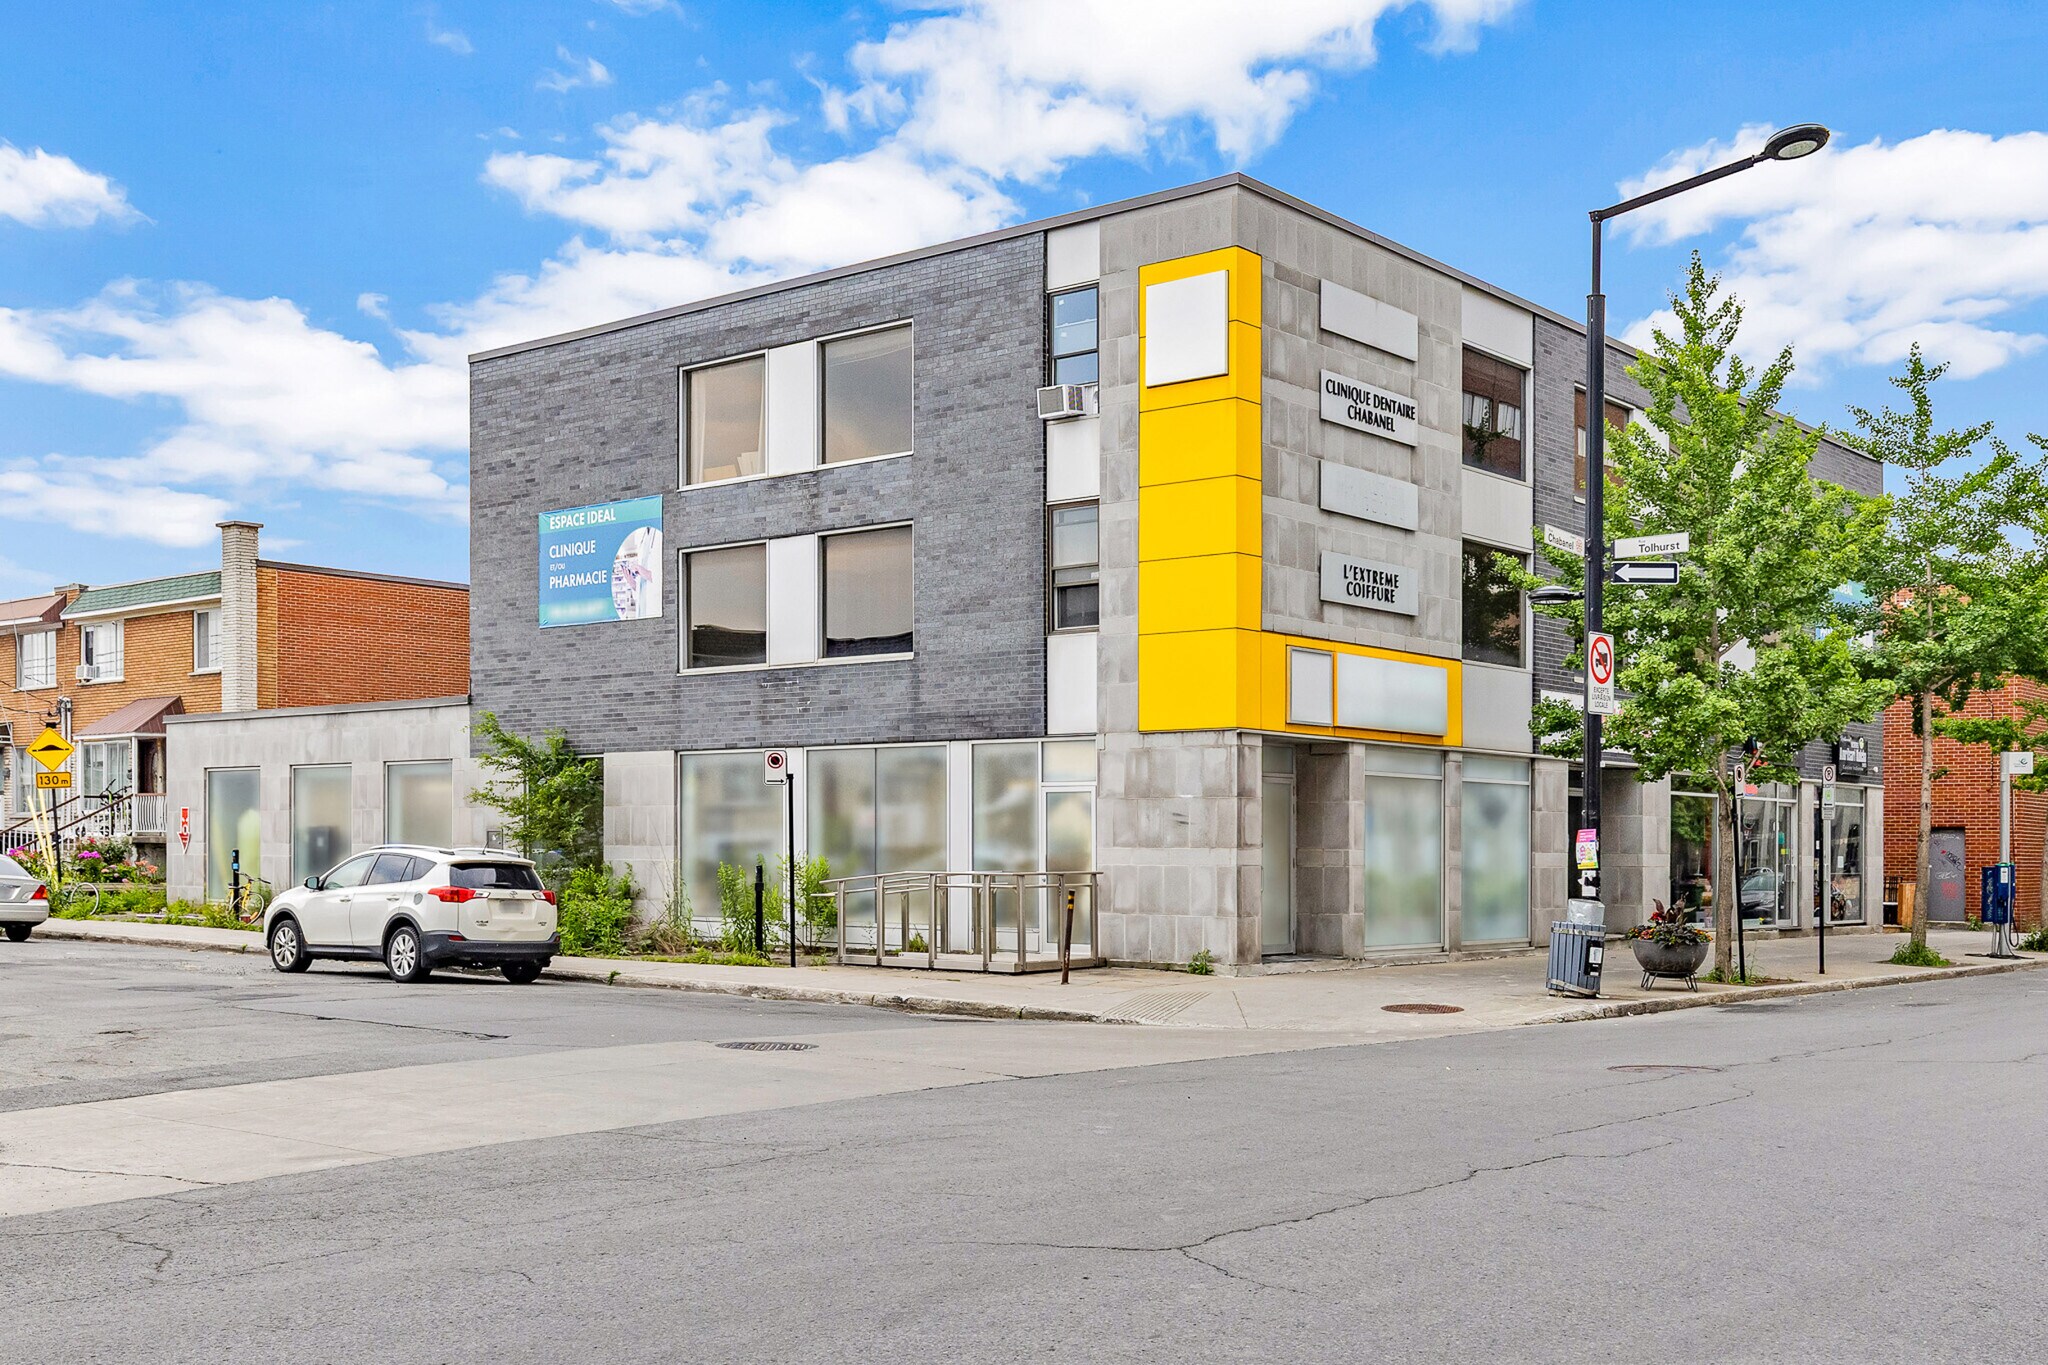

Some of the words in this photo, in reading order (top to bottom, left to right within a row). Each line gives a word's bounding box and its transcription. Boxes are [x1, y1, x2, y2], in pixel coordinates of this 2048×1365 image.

[1326, 379, 1371, 406] CLINIQUE
[1373, 394, 1416, 420] DENTAIRE
[1347, 405, 1395, 432] CHABANEL
[550, 513, 585, 529] ESPACE
[587, 508, 616, 525] IDEAL
[549, 540, 596, 559] CLINIQUE
[1638, 542, 1680, 553] Tolhurst
[549, 570, 607, 589] PHARMACIE
[1344, 564, 1399, 588] L'EXTREME
[1347, 582, 1395, 603] COIFFURE
[40, 776, 59, 785] 130
